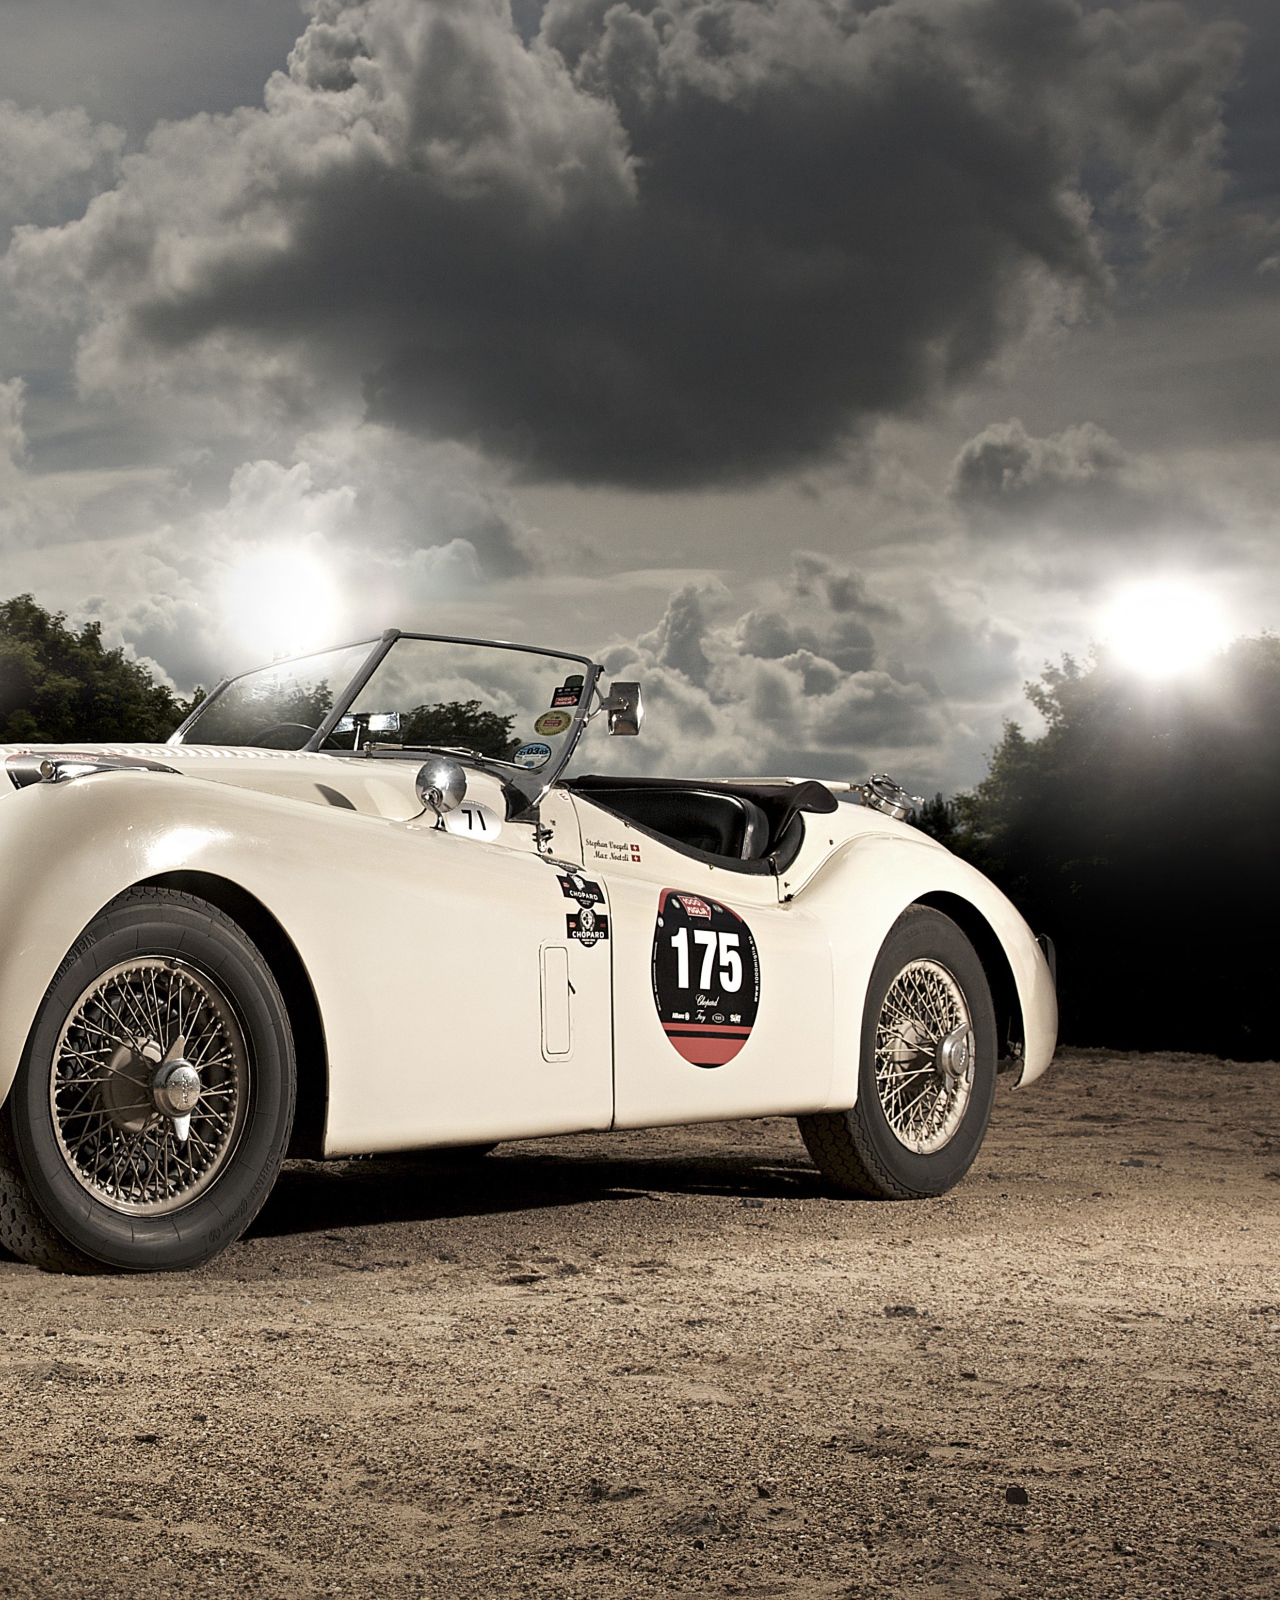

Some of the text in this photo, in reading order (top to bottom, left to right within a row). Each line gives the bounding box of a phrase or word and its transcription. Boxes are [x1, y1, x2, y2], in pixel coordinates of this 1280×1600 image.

[461, 809, 487, 830] 71
[593, 850, 608, 859] Max
[569, 890, 599, 901] CHOPARD
[682, 897, 701, 906] 1000
[687, 906, 708, 915] MIGLIA
[572, 930, 605, 938] CHOPARD
[670, 927, 743, 993] 175
[695, 993, 720, 1008] Chopard
